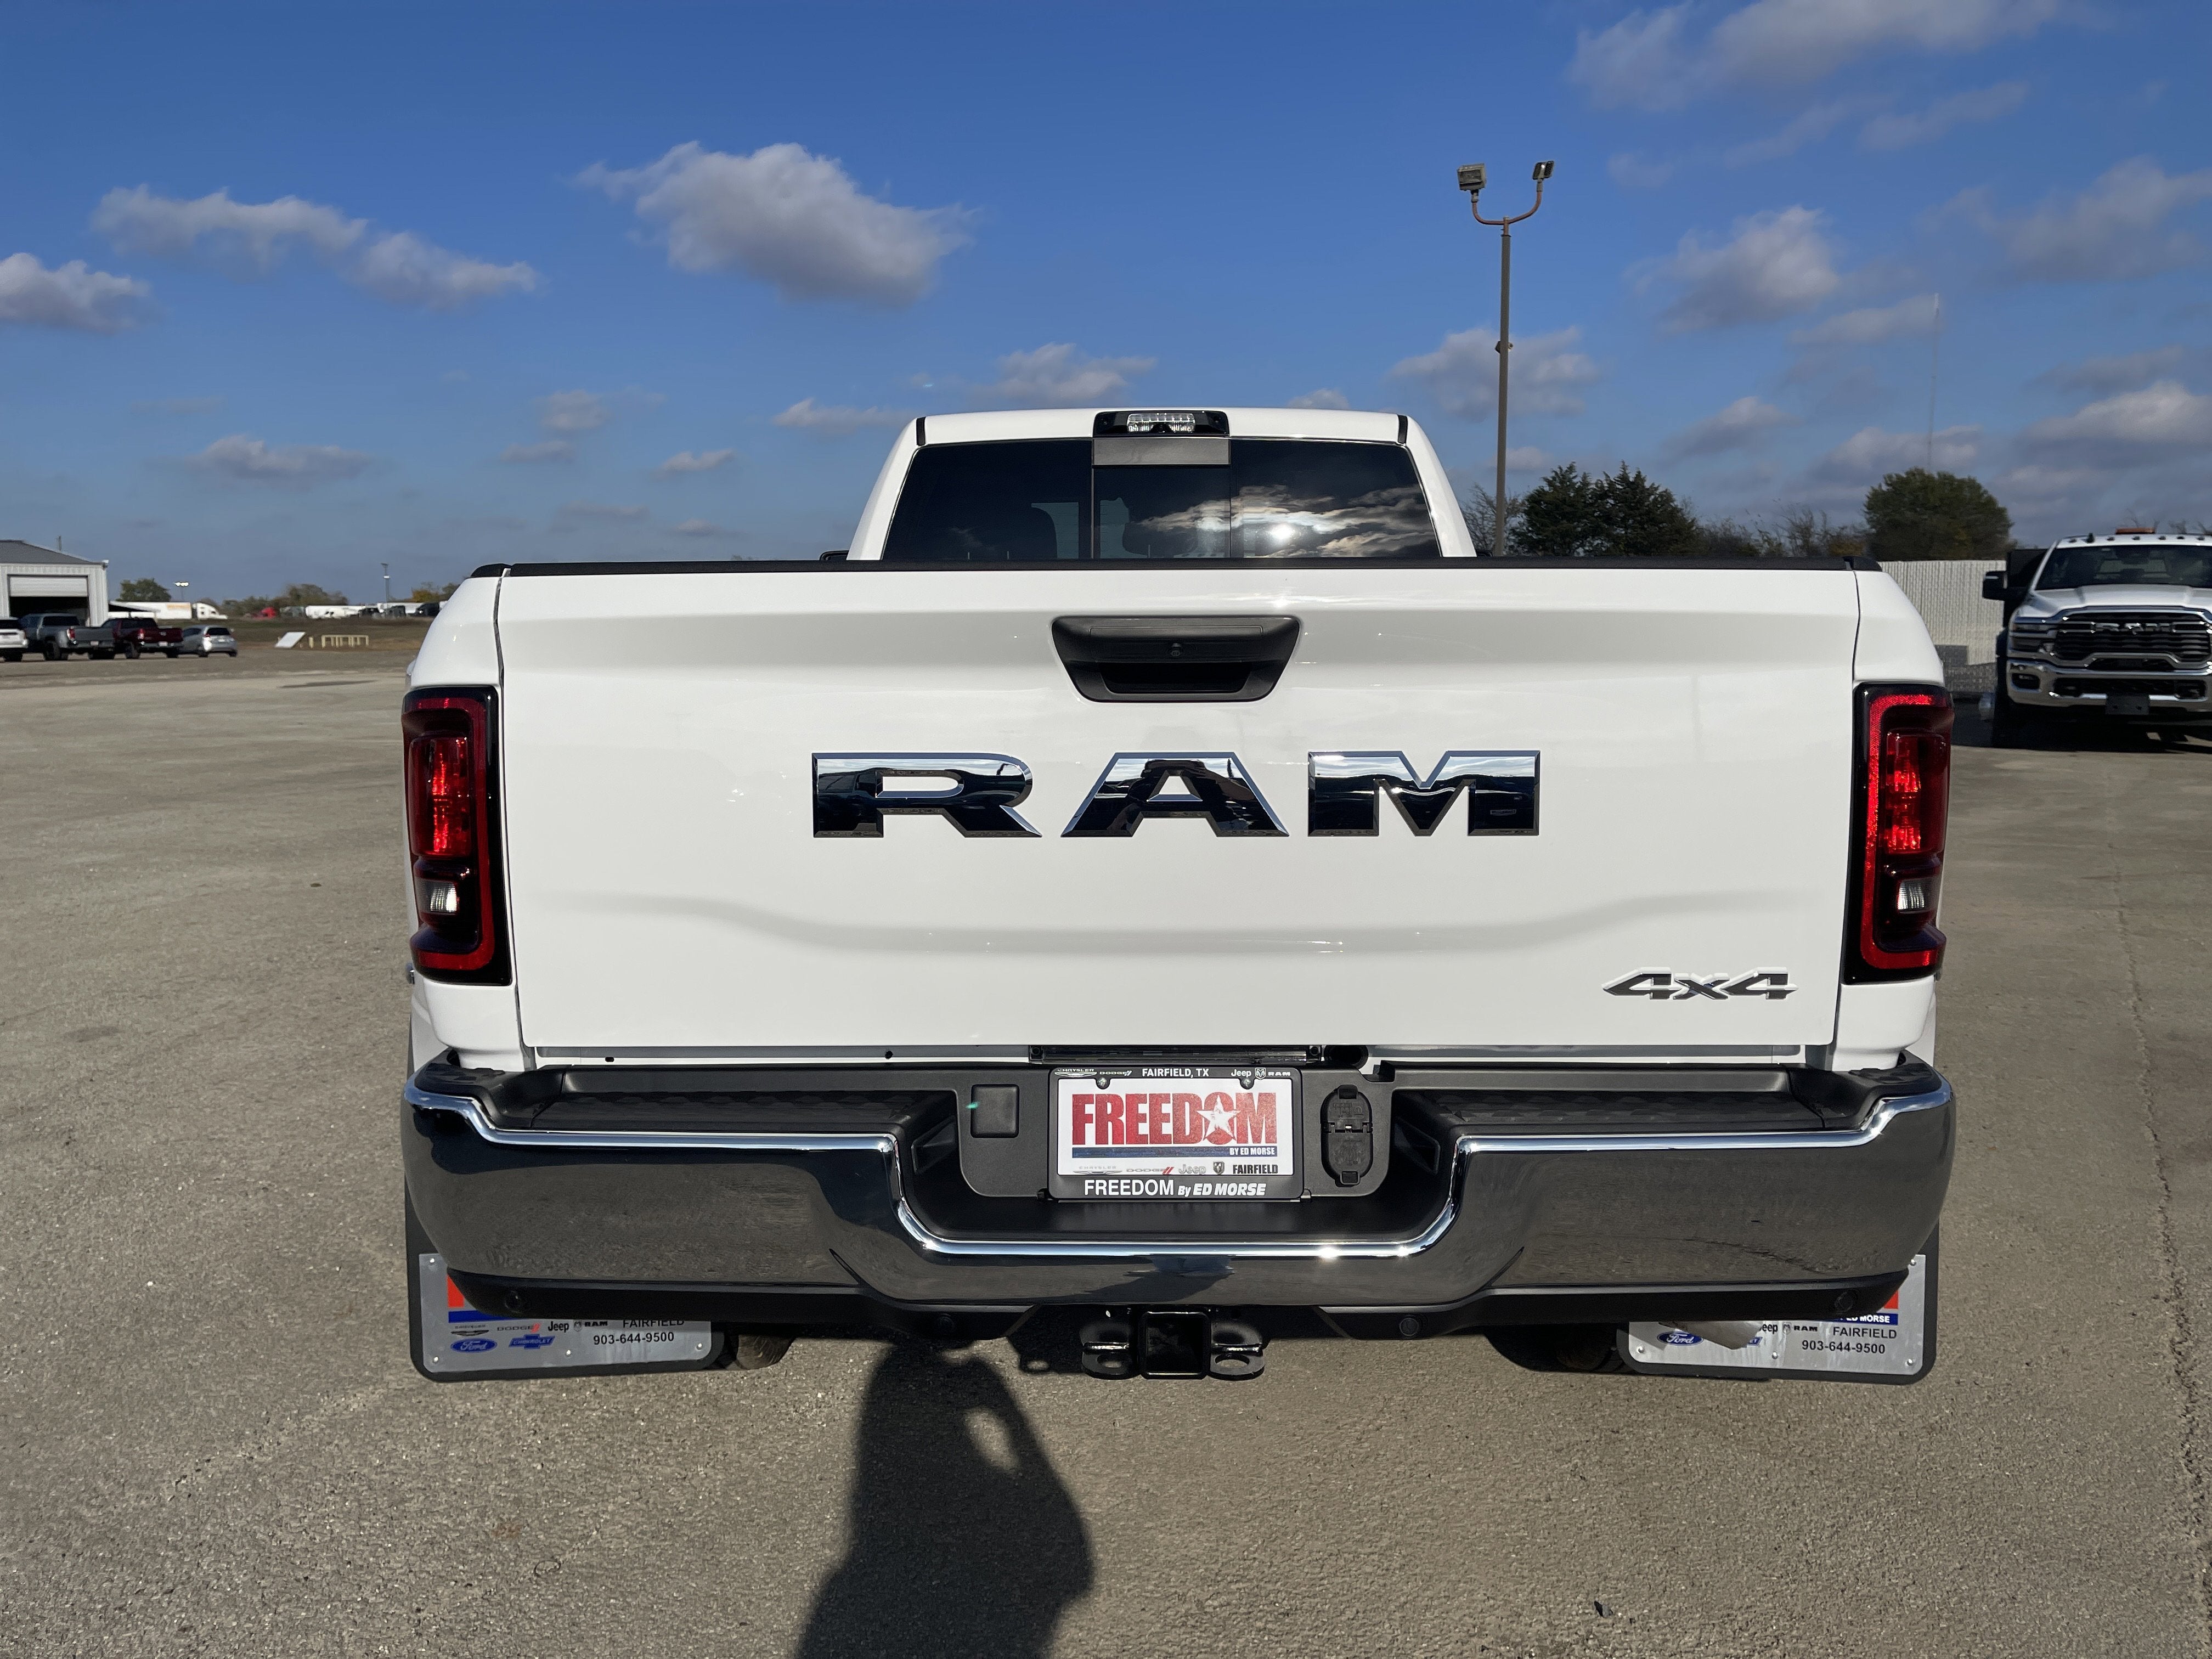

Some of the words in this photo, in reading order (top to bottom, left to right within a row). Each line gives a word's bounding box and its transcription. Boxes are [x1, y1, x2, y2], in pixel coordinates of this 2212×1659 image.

[812, 752, 1541, 837] RAM
[1142, 1068, 1193, 1078] FAIRFIELD,
[1196, 1068, 1209, 1077] TX
[1231, 1069, 1251, 1077] Jeep
[1072, 1092, 1278, 1145] FREEDOM
[1178, 1164, 1206, 1175] Jeep
[1233, 1164, 1278, 1174] FAIRFIELD
[1084, 1180, 1173, 1195] FREEDOM
[1177, 1185, 1192, 1197] By
[1193, 1183, 1212, 1195] ED
[1214, 1183, 1266, 1196] MORSE
[1860, 1314, 1890, 1323] MORSE
[548, 1321, 569, 1333] Jeep
[1759, 1324, 1778, 1335] eep
[593, 1332, 674, 1345] 903-644-9500
[1667, 1333, 1694, 1344] Ford
[1833, 1327, 1897, 1339] FAIRFIELD
[460, 1341, 487, 1351] Ford
[1802, 1340, 1886, 1354] 903-644-9500
